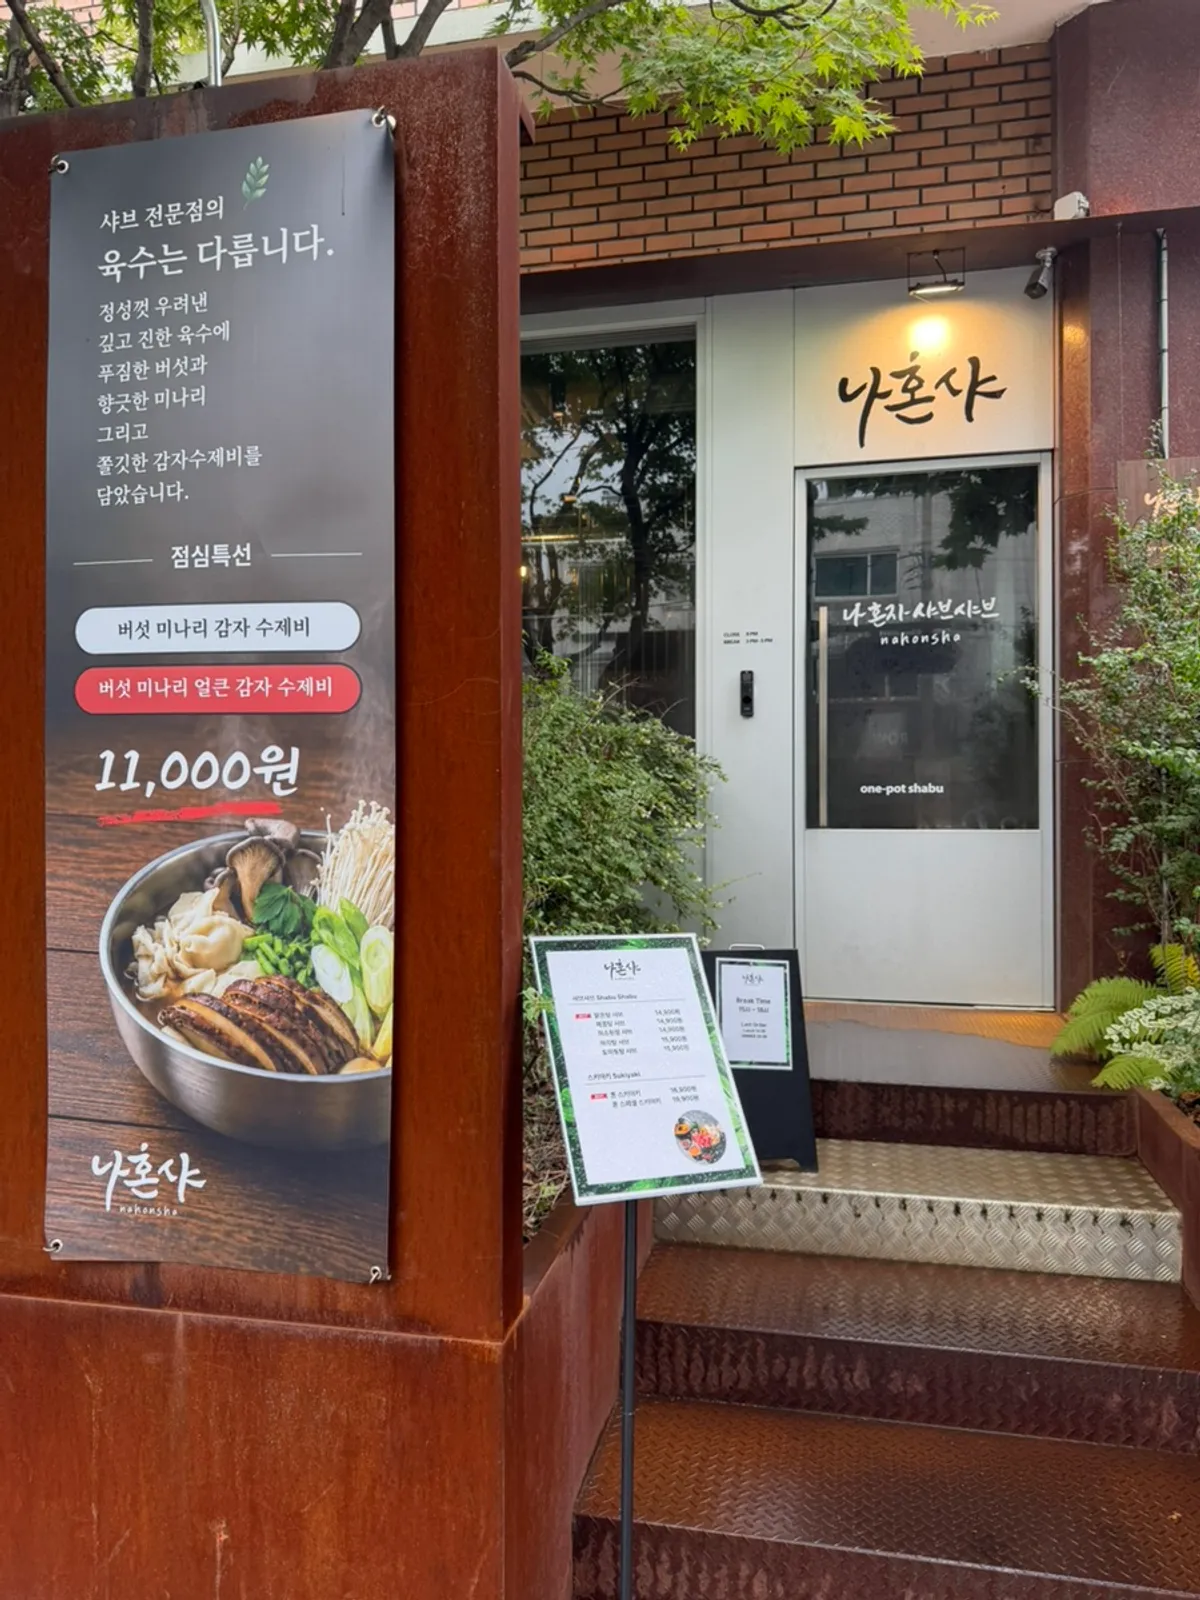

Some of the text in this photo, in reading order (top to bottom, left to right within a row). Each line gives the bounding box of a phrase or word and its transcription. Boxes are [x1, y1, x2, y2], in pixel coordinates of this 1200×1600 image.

[100, 196, 224, 233] 샤브 전문점의
[98, 224, 334, 283] 육수는 다릅니다.
[99, 291, 208, 322] 정성껏 우려낸
[98, 321, 231, 353] 깊고 진한 육수에
[97, 354, 208, 384] 푸짐한 버섯과
[97, 385, 206, 415] 향긋한 미나리
[837, 350, 1007, 448] 나혼샤
[96, 423, 149, 443] 그리고
[96, 445, 262, 476] 쫄깃한 감자수제비를
[97, 481, 189, 506] 담았습니다.
[171, 543, 252, 569] 점심특선
[842, 597, 1000, 628] 나혼자 샤브샤브
[117, 616, 310, 640] 버섯 미나리 감자 수제비
[880, 630, 961, 646] nahonsha
[99, 676, 333, 699] 버섯 미나리 얼큰 감자 수제비
[94, 745, 300, 798] 11,000원
[860, 782, 944, 796] one-pot shabu
[91, 1142, 207, 1212] 나혼샤
